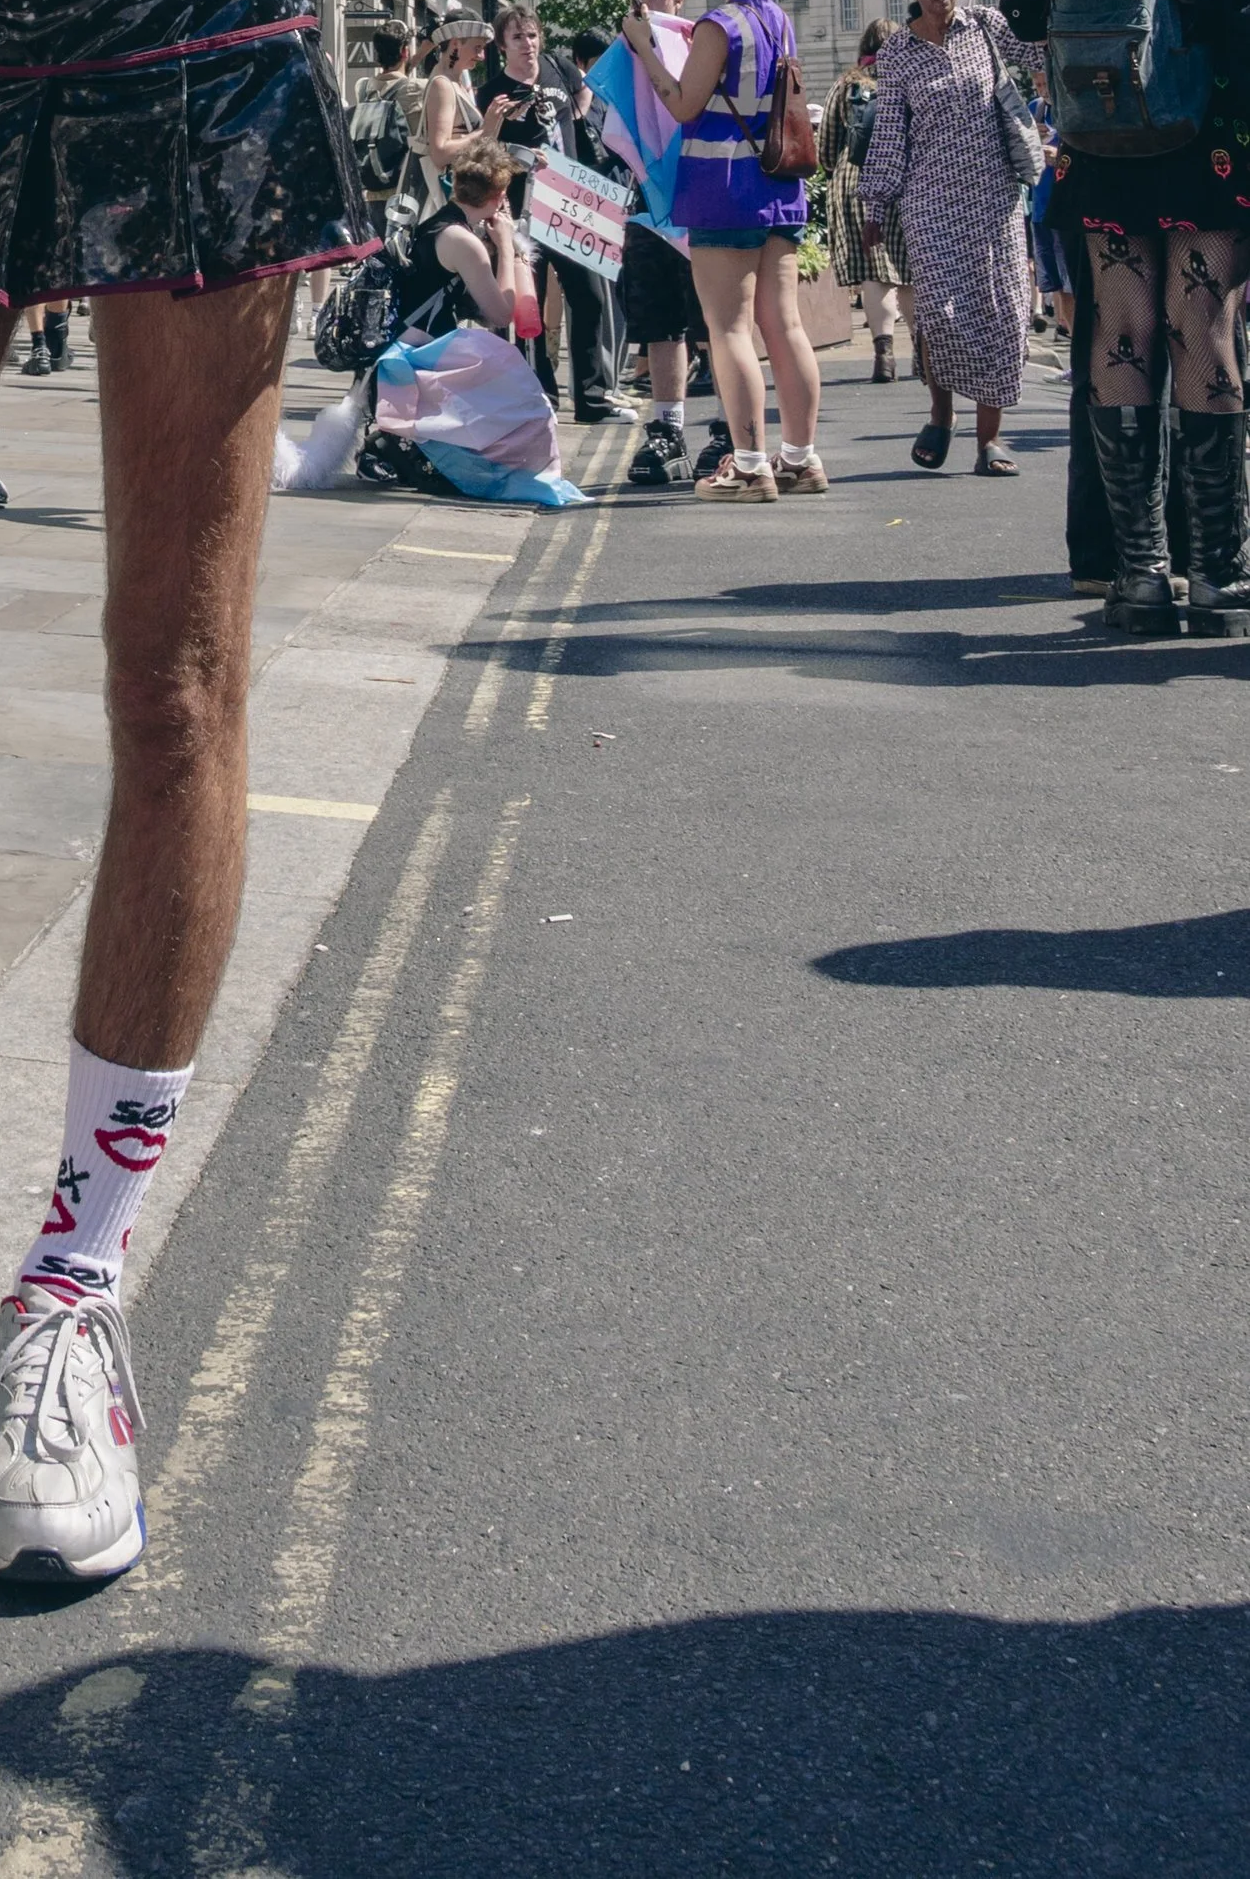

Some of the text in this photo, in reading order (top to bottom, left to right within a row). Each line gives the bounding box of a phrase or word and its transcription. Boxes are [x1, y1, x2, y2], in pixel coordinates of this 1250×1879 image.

[568, 164, 619, 201] TRANS
[571, 185, 605, 211] JOY
[560, 198, 595, 226] IS A
[36, 1255, 117, 1296] sex
